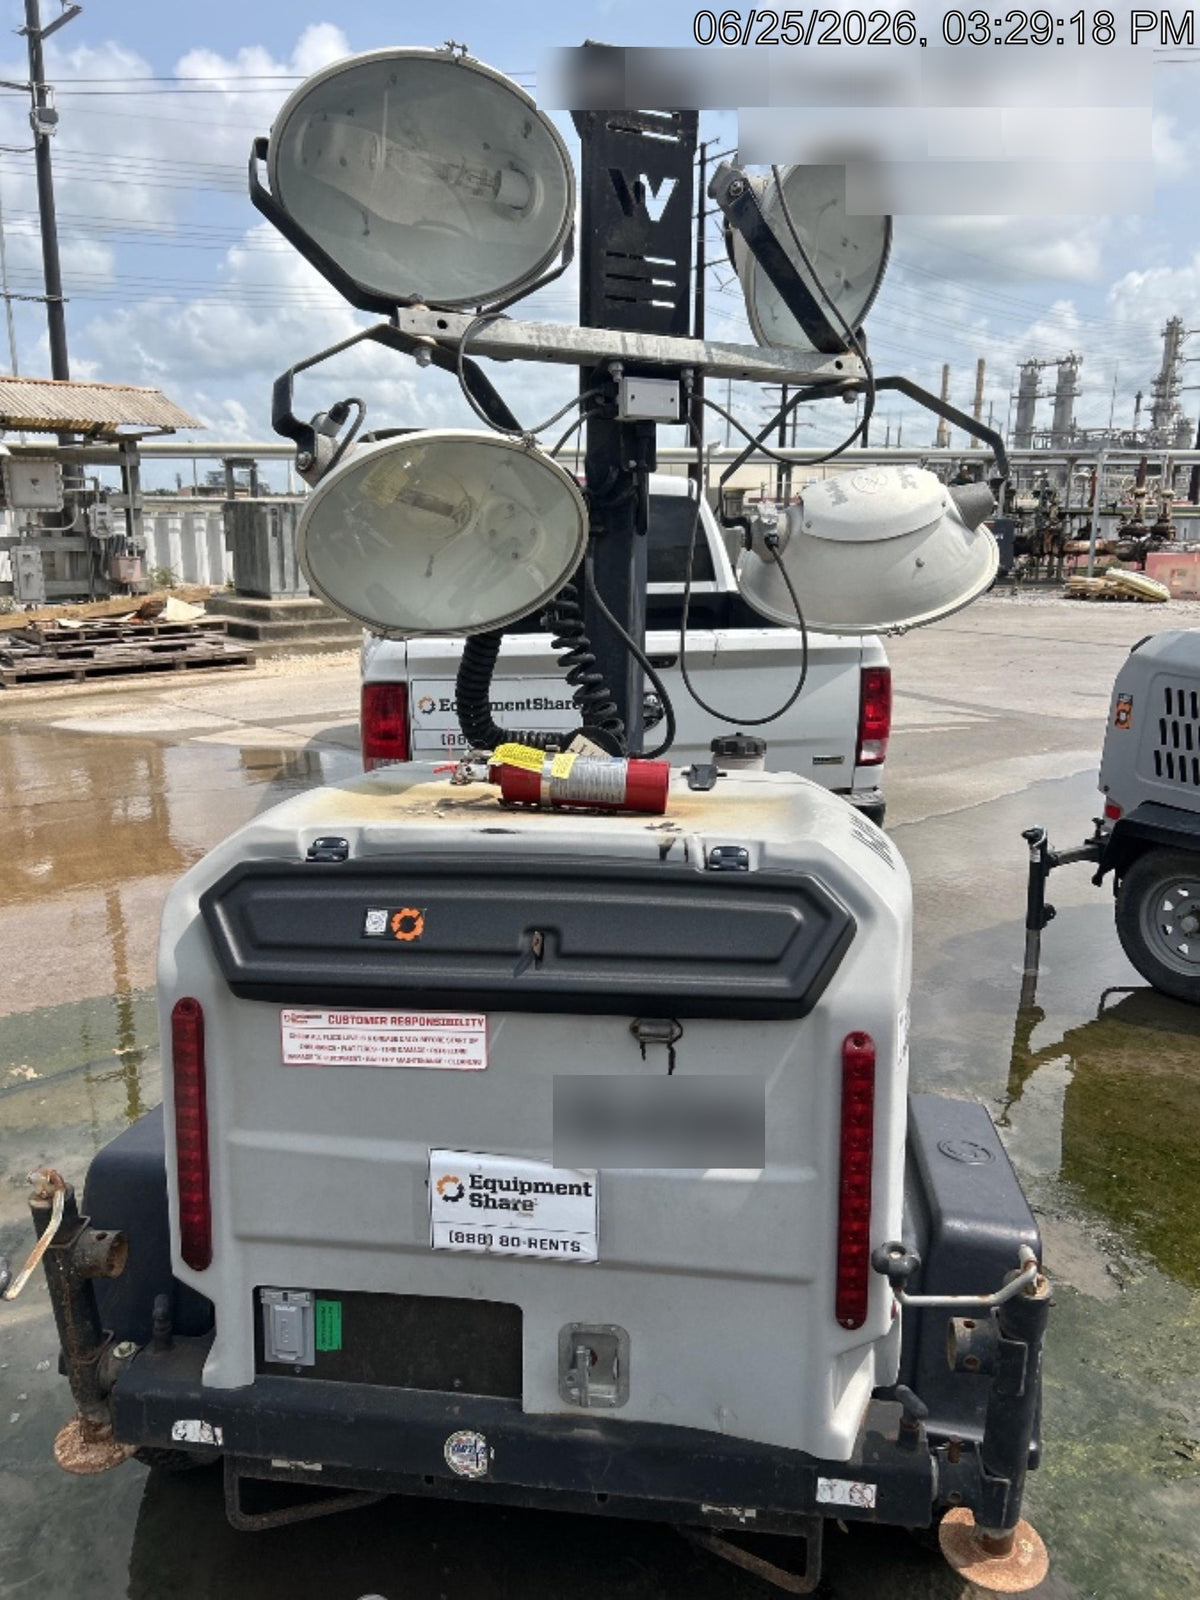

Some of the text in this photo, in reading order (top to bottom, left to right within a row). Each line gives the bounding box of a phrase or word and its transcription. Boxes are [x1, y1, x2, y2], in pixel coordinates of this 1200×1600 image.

[468, 1174, 593, 1197] Equipment
[468, 1193, 535, 1212] Share
[449, 1231, 581, 1252] (888) 80-RENTS
